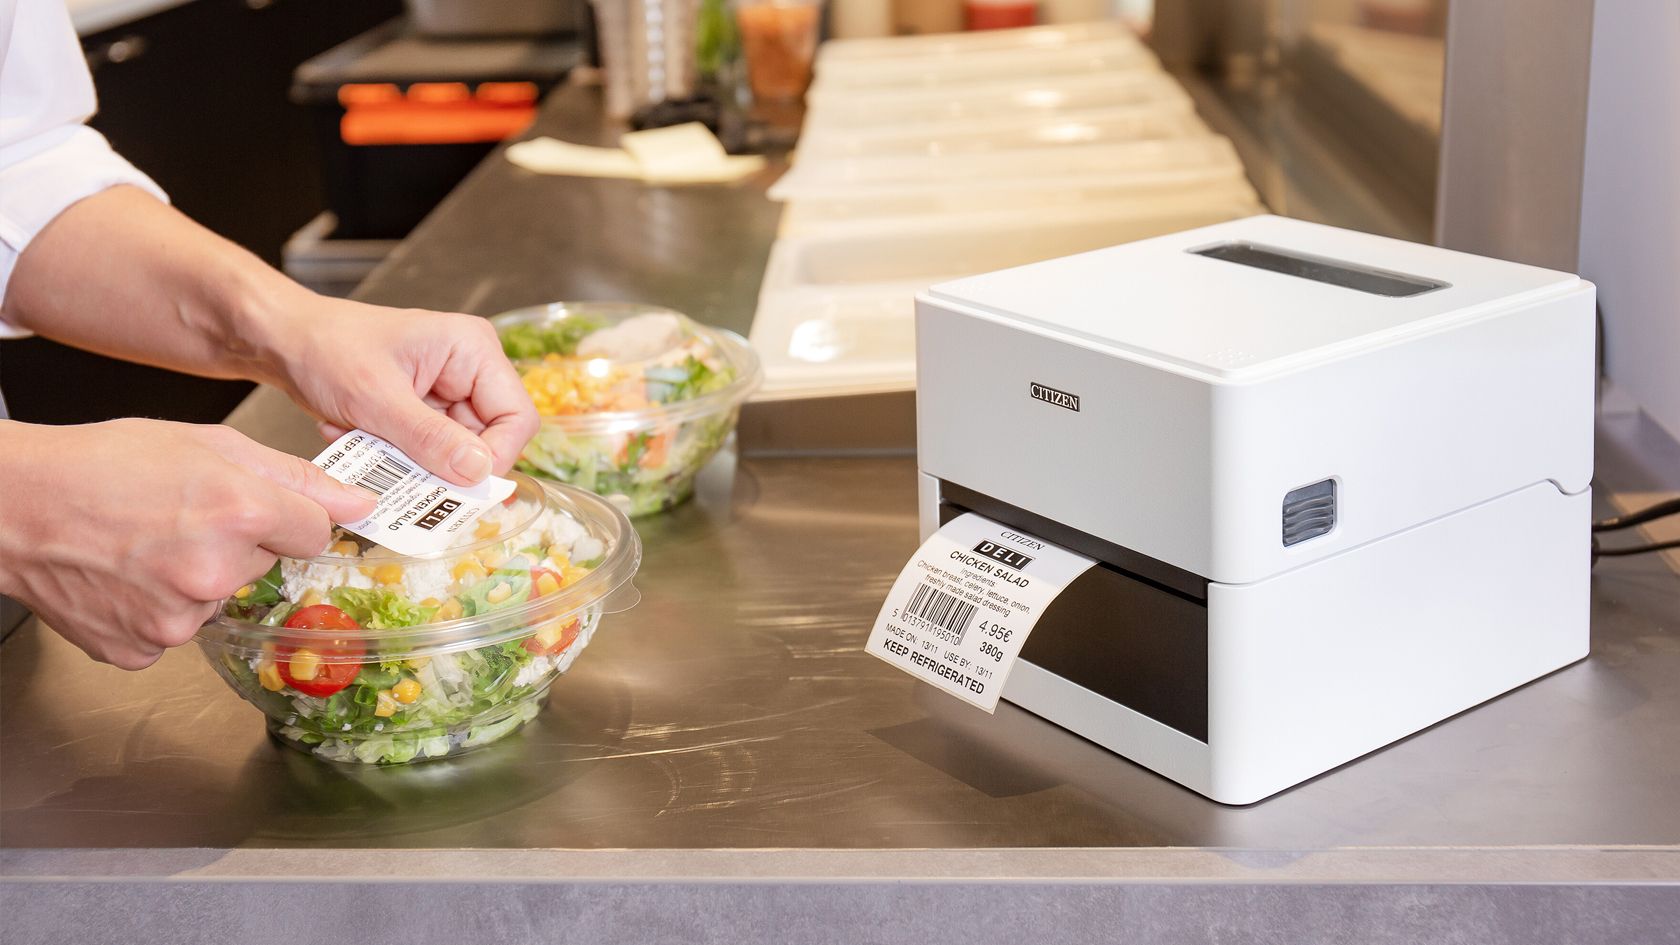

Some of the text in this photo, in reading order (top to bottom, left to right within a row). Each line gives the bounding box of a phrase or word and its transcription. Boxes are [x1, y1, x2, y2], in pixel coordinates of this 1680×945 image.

[1031, 384, 1078, 410] CITIZEN
[342, 434, 364, 451] KEEP
[387, 485, 446, 530] CHICKEN SALAD
[420, 501, 457, 528] DELI
[1001, 531, 1045, 551] CITIZEN
[980, 543, 1026, 567] DELI
[950, 551, 1029, 588] CHICKEN SALAD
[918, 560, 942, 575] Chicken
[964, 582, 985, 595] celery,
[987, 590, 1009, 605] lettuce,
[1011, 600, 1030, 614] onion,
[925, 574, 1010, 618] freshly made salad dressing
[892, 608, 899, 617] 5
[979, 621, 1012, 642] 4.95€
[886, 623, 993, 679] MADE ON: 13/11 USE BY: 13/11
[980, 642, 1003, 662] 380g
[884, 639, 984, 694] KEEP REFRIGERATED
